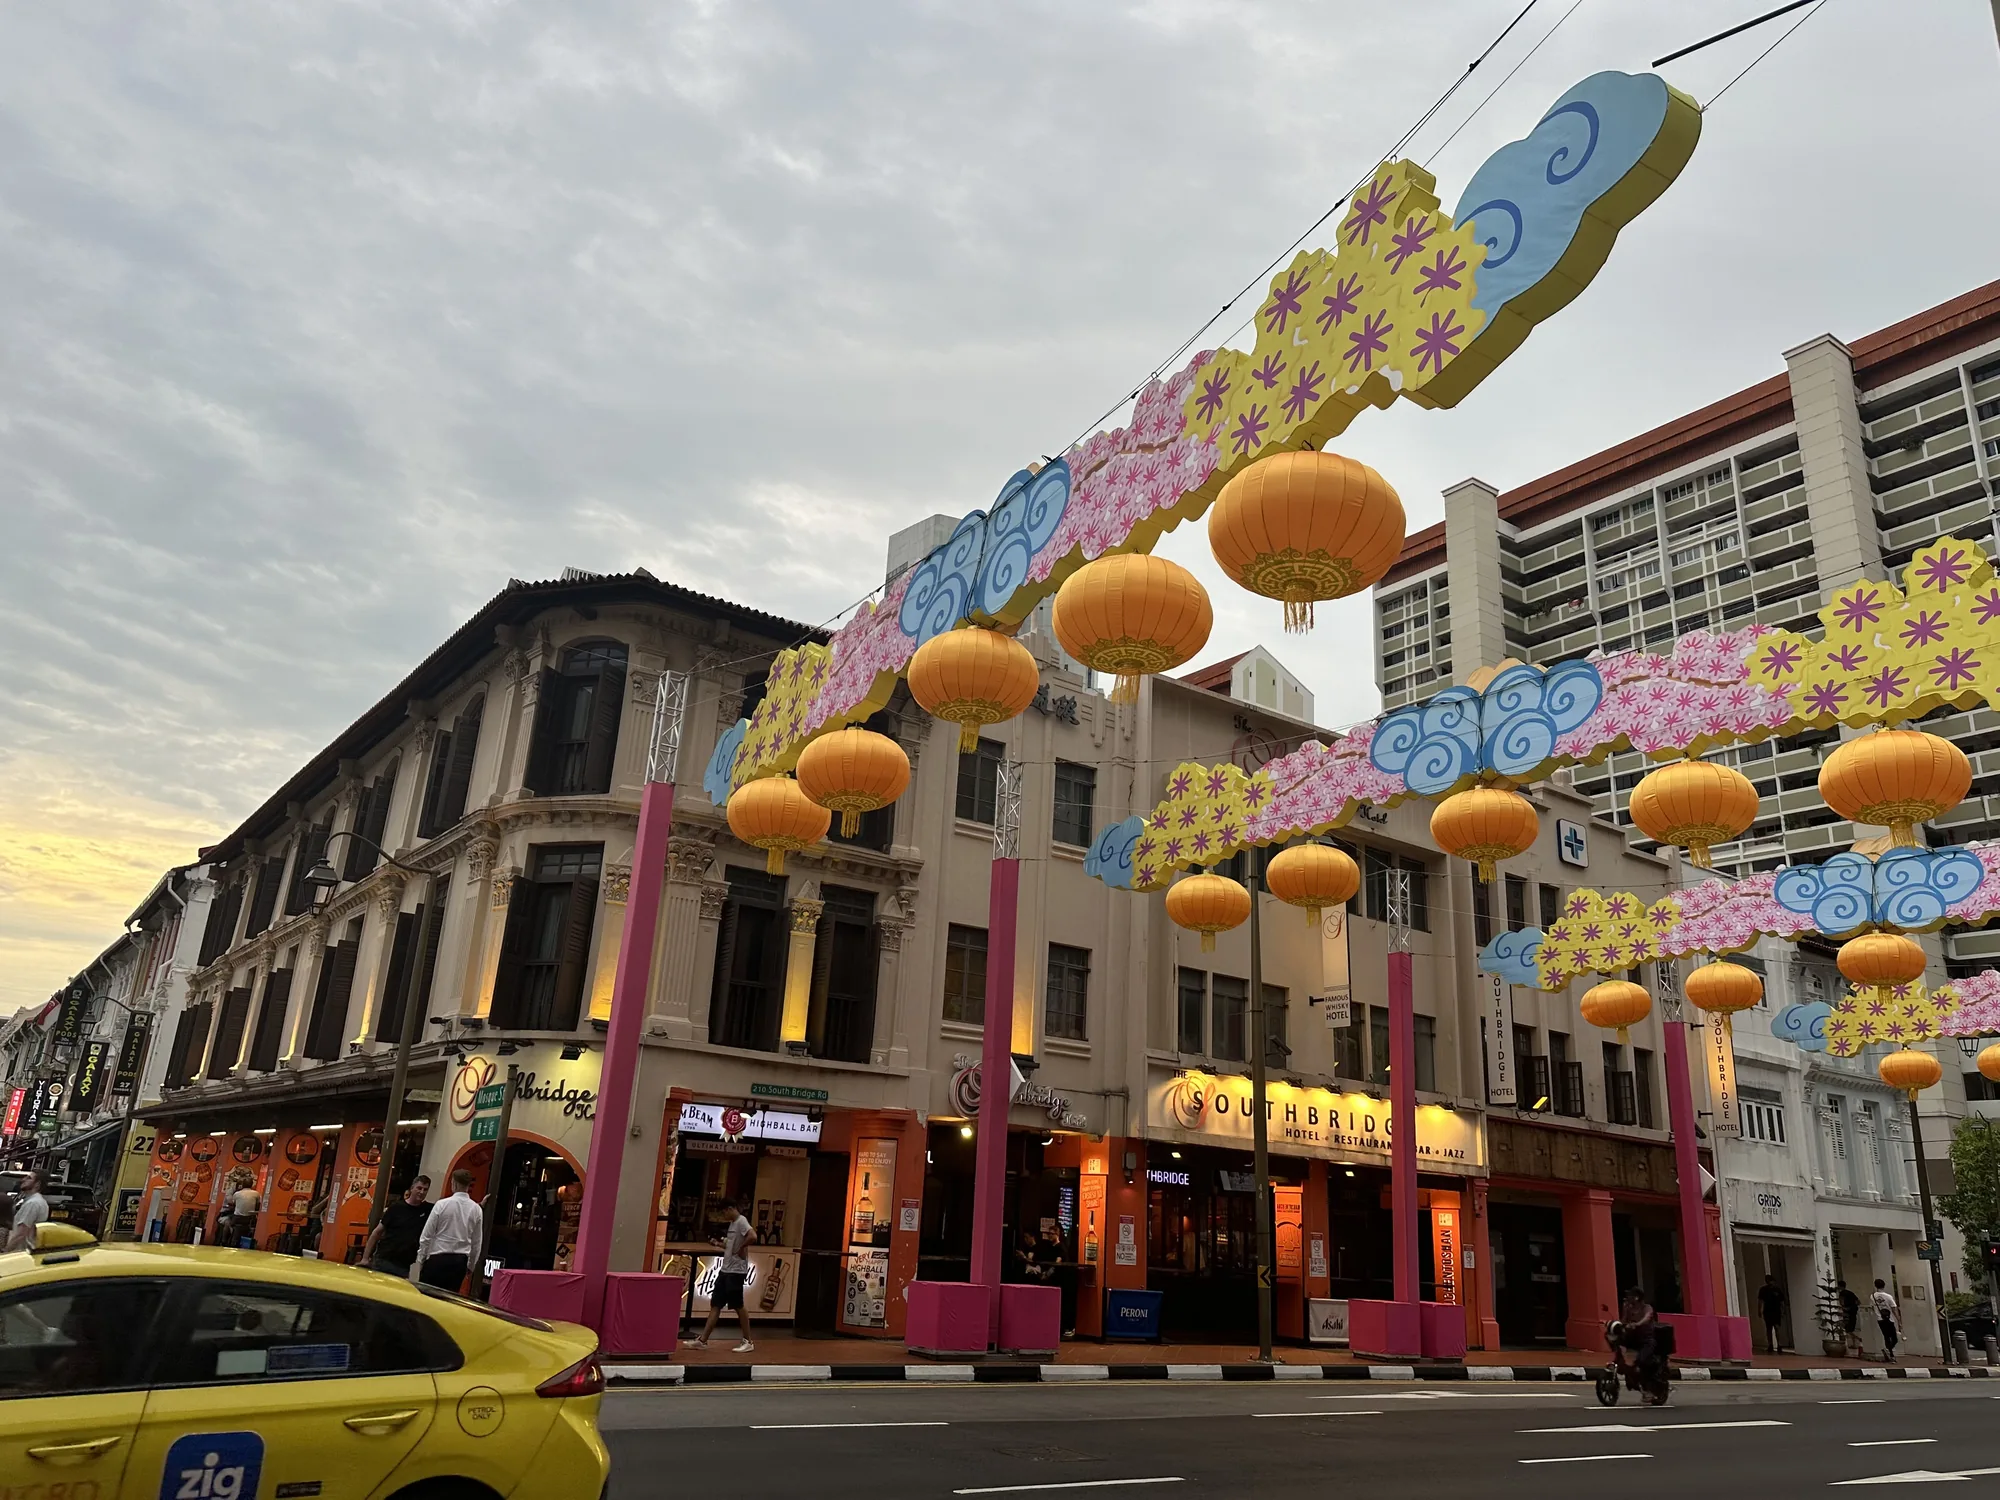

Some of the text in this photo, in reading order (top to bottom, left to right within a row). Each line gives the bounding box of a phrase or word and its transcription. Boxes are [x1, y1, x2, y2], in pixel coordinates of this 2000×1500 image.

[1324, 994, 1348, 1002] FAMOUS
[1325, 1003, 1348, 1011] WHISKY
[64, 1000, 80, 1031] GALAXY
[1326, 1011, 1348, 1021] HOTEL
[55, 1030, 77, 1038] PODS
[1493, 977, 1506, 1082] OUTHBRIDGE
[128, 1031, 140, 1068] GALAXY
[1173, 1069, 1188, 1079] THE
[1714, 1018, 1729, 1119] SOUTHBRIDGE
[81, 1056, 98, 1097] GALAXY
[120, 1081, 130, 1089] 27
[752, 1085, 828, 1099] 210 South Bridge Rd
[1490, 1087, 1515, 1097] HOTEL
[1193, 1090, 1392, 1135] SOUTHBRIDG
[750, 1119, 818, 1133] HIGHBALL BAR
[1716, 1124, 1738, 1132] HOTEL
[133, 1136, 155, 1152] 27
[692, 1141, 755, 1152] ULTIMATE HIGHB
[1286, 1128, 1319, 1141] HOTEL
[1334, 1134, 1392, 1150] RESTAURAN
[1443, 1148, 1465, 1159] JAZZ
[1146, 1169, 1190, 1186] THBRIDGE
[854, 1251, 870, 1264] VERY
[850, 1264, 884, 1274] HIGHBALL
[1120, 1306, 1148, 1318] PERONI
[1322, 1317, 1344, 1331] Asahi
[177, 1452, 245, 1500] zig
